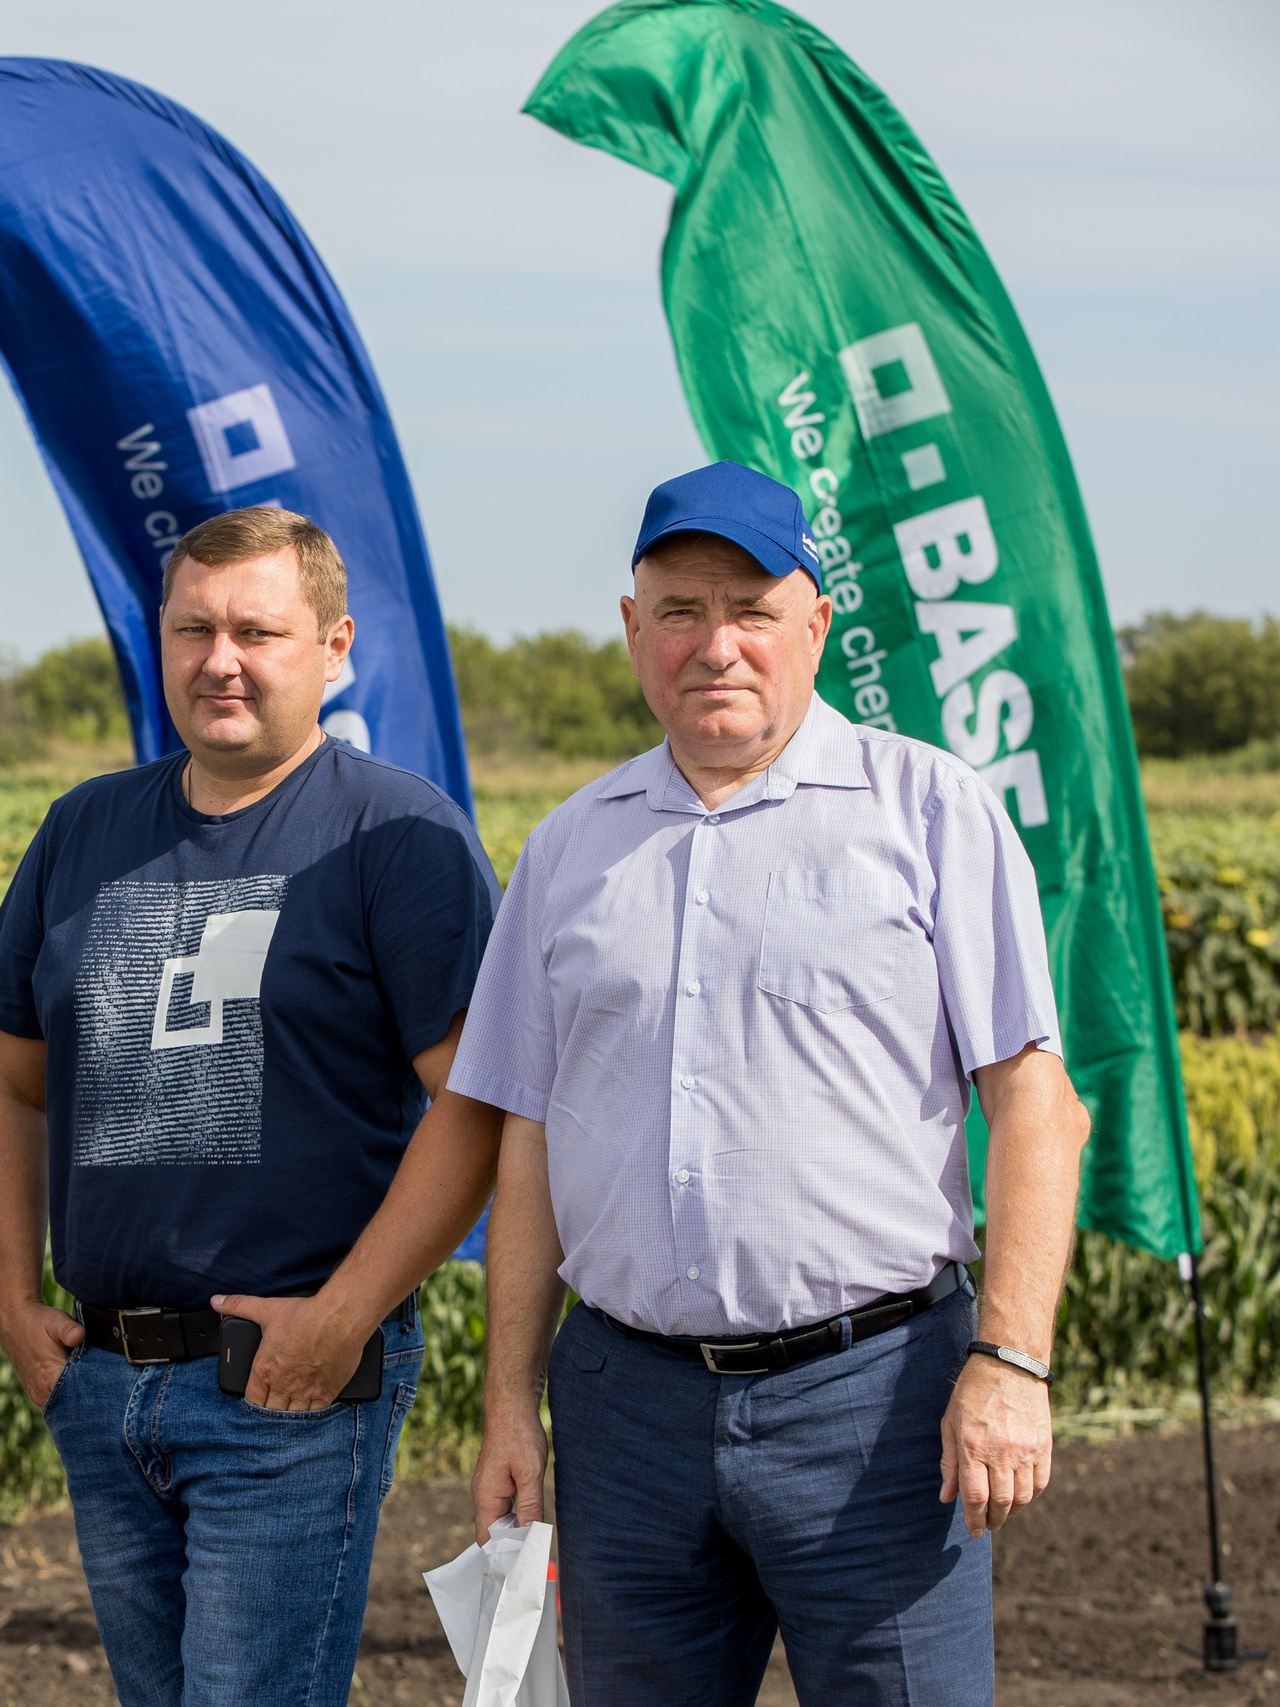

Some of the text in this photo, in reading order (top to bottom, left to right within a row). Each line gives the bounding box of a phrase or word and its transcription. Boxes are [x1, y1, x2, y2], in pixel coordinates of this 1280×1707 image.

[778, 371, 826, 459] We
[116, 422, 168, 500] We
[893, 495, 1049, 828] BASF
